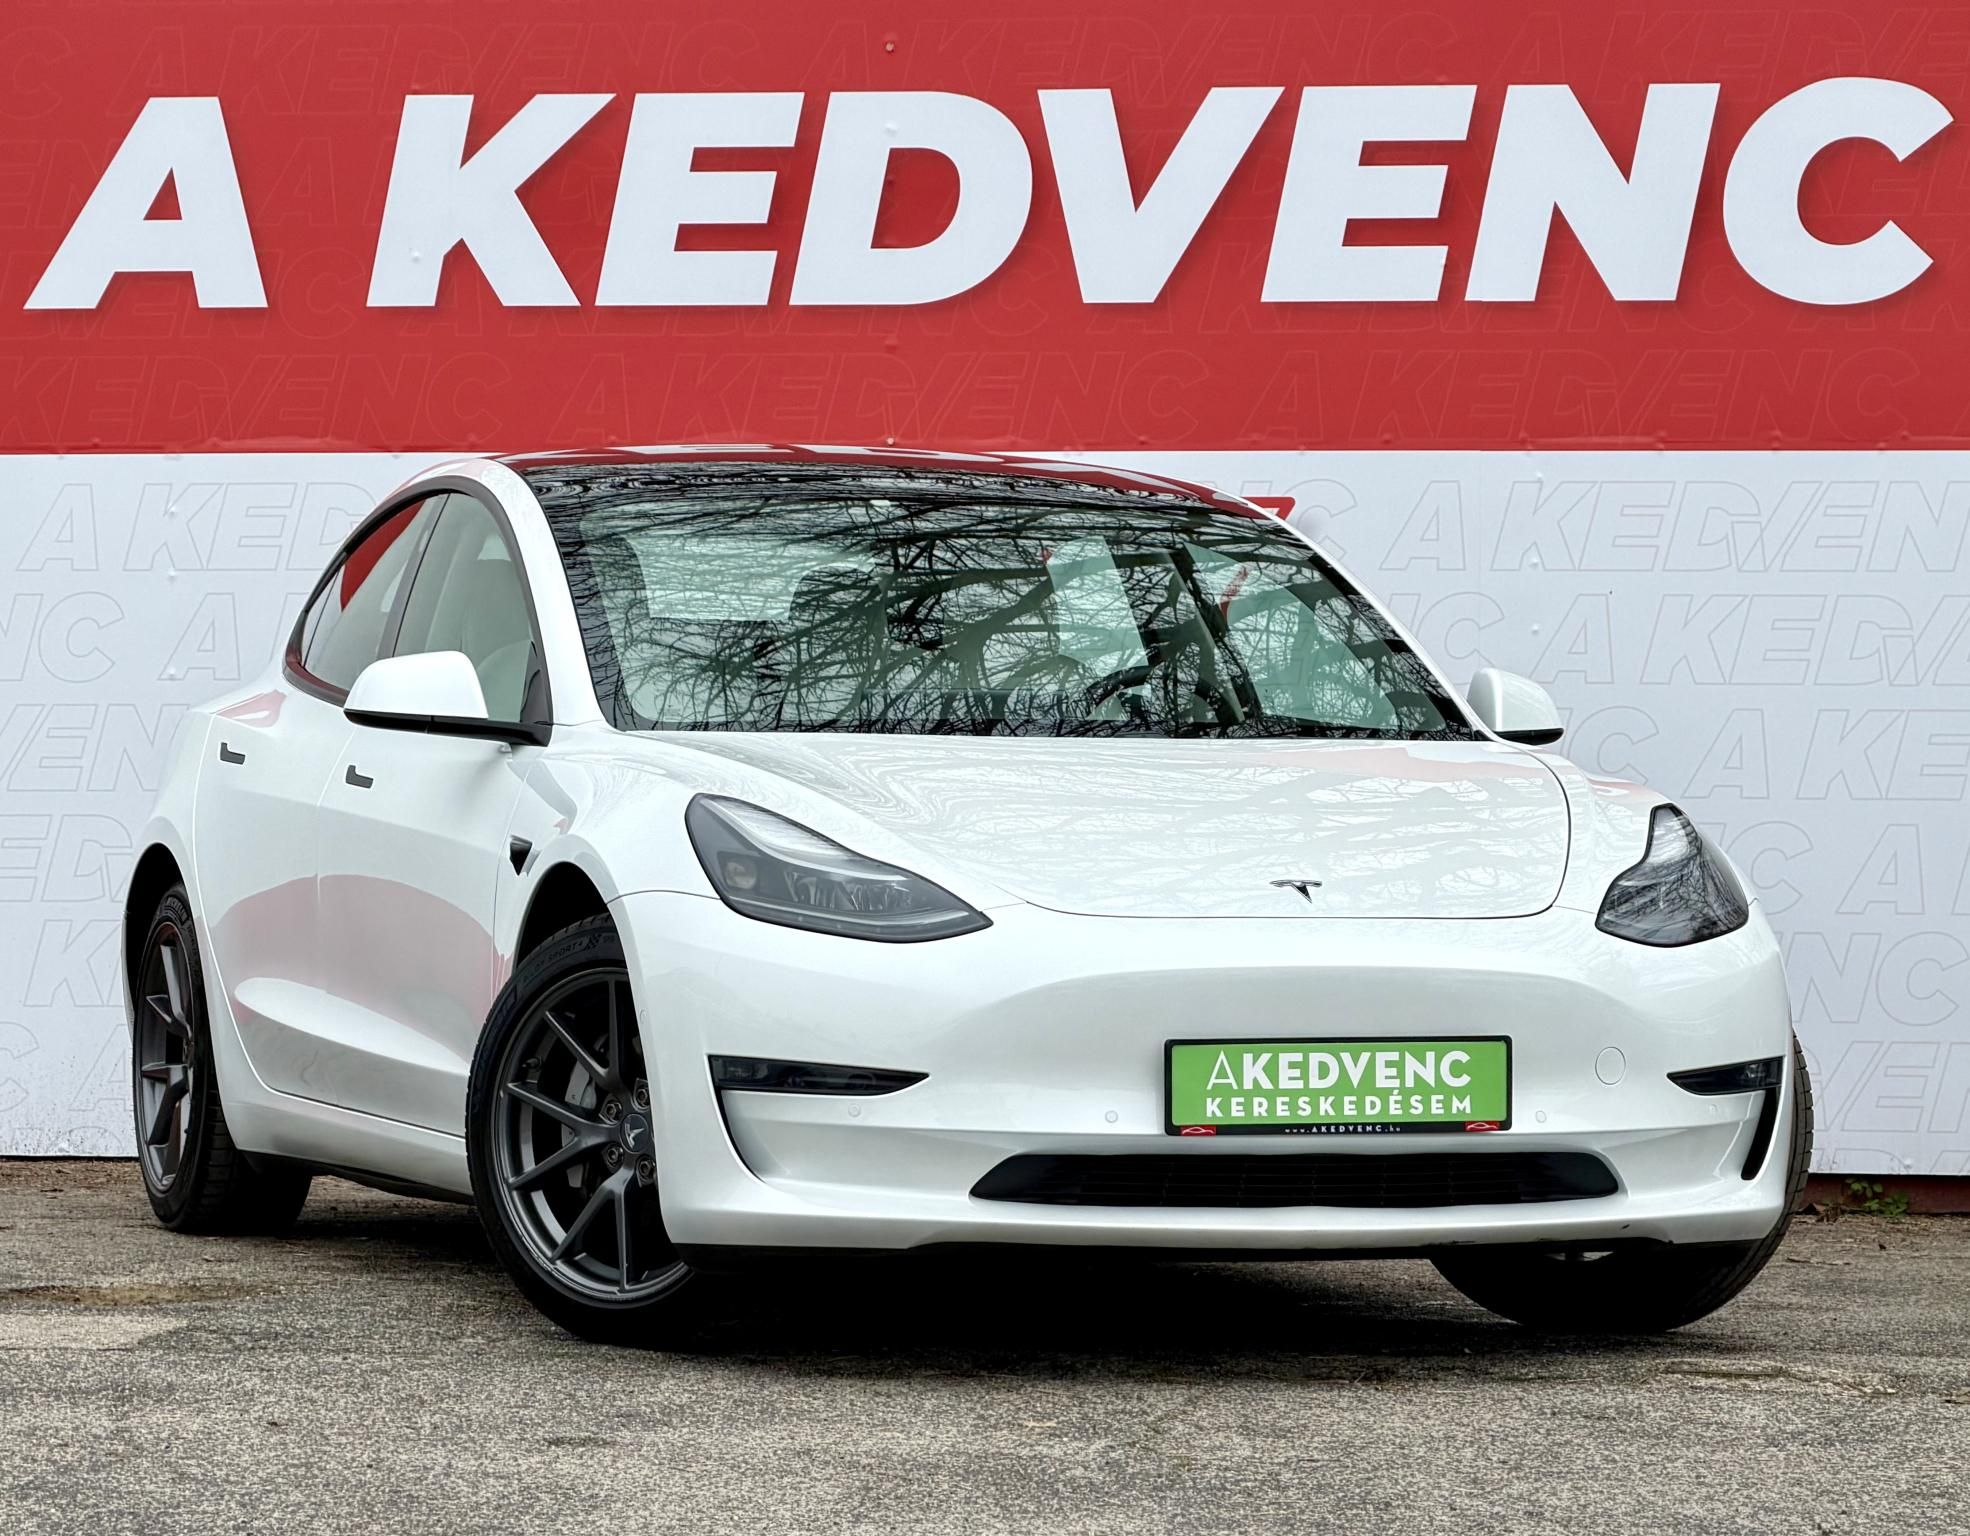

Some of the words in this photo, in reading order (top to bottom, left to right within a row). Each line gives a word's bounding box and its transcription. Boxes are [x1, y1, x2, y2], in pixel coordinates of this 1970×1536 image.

[22, 96, 269, 310] A
[365, 76, 1954, 309] KEDVENC
[15, 482, 99, 572] A
[1378, 480, 1467, 572] A
[156, 591, 241, 681] A
[1206, 1090, 1472, 1118] KERESKEDÉSEM
